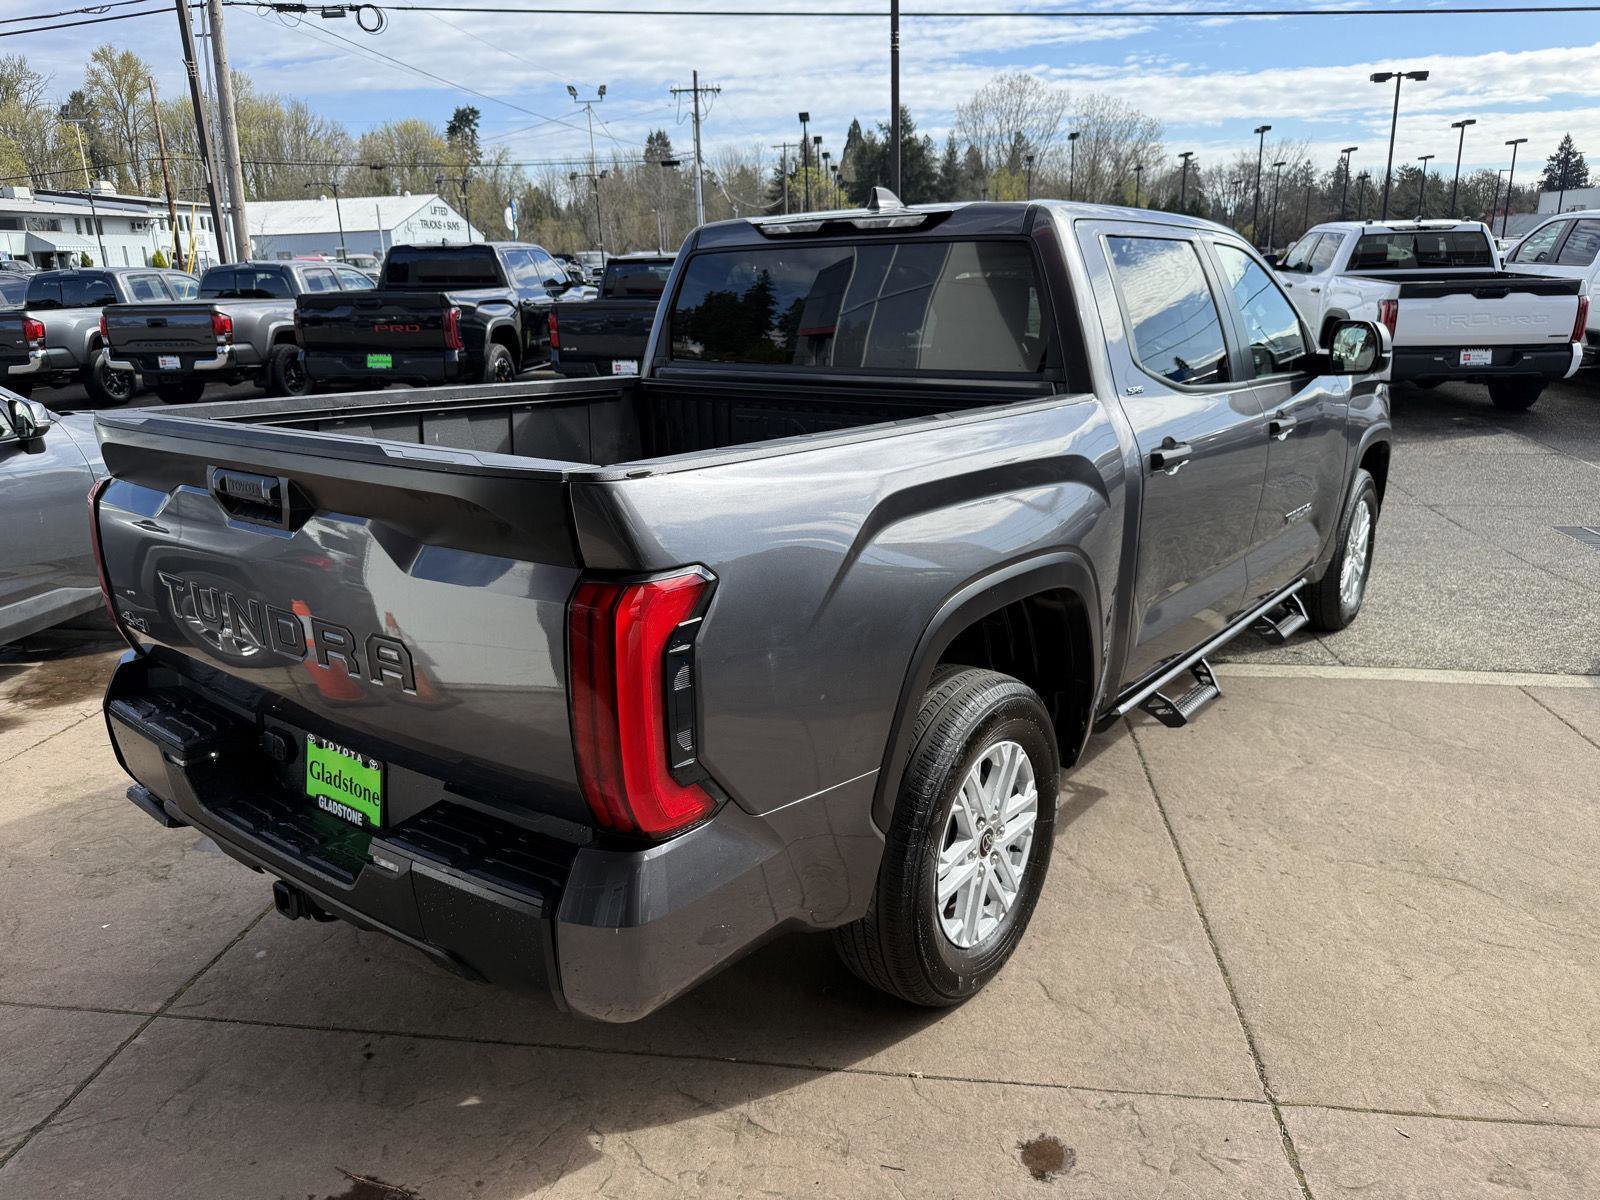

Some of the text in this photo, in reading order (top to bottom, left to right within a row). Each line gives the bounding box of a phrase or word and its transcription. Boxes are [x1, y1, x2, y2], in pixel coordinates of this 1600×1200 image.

[420, 219, 442, 230] TRUCKS
[430, 206, 448, 216] LIFTED
[158, 570, 417, 696] TUNDRA
[322, 739, 363, 764] TOYOTA
[309, 760, 380, 807] Gladstone
[318, 795, 363, 827] GLADSTONE
